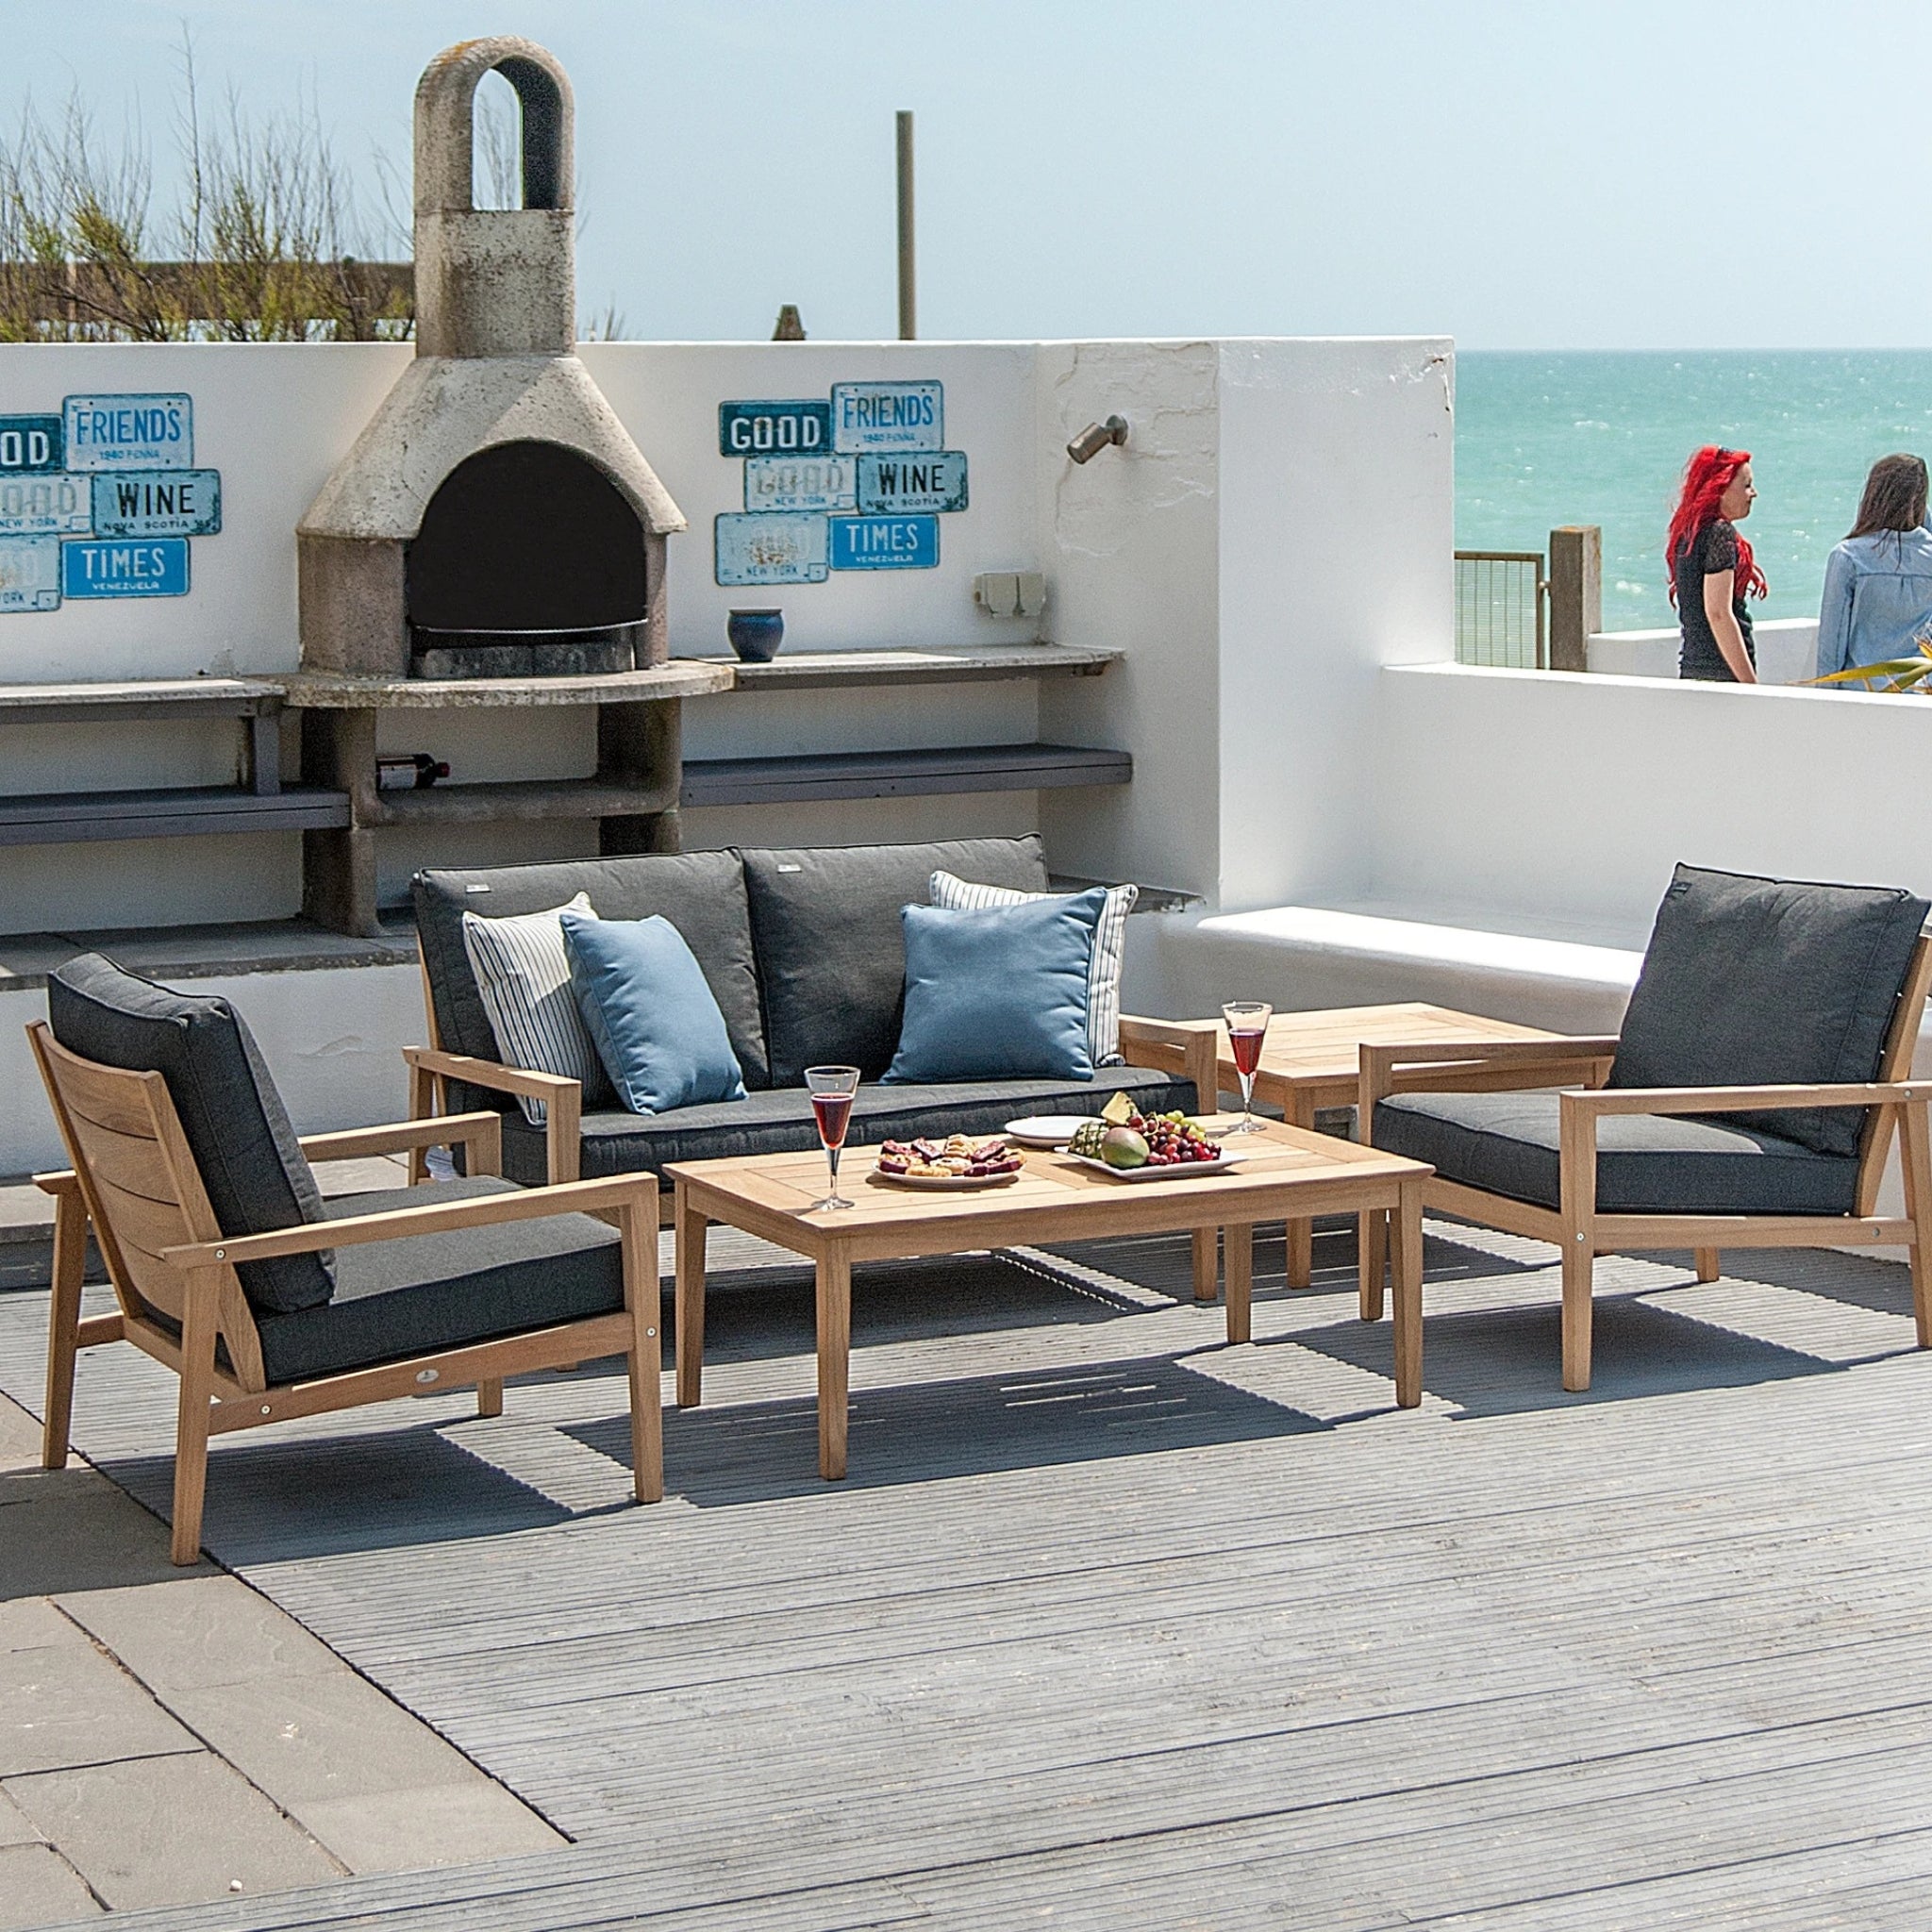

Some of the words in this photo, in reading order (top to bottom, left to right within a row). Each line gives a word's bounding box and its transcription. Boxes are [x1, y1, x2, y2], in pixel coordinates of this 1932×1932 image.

[76, 408, 181, 444] FRIENDS
[843, 394, 933, 428] FRIENDS
[730, 416, 821, 449] GOOD
[757, 463, 843, 495] GOOD
[878, 462, 946, 495] WINE
[116, 482, 195, 518] WINE
[900, 496, 941, 508] SCOTIA
[144, 519, 189, 529] SCOTIA
[845, 523, 919, 553] TIMES
[80, 547, 166, 579] TIMES
[856, 554, 914, 564] VENEZUELA
[92, 580, 160, 591] VENEZUELA
